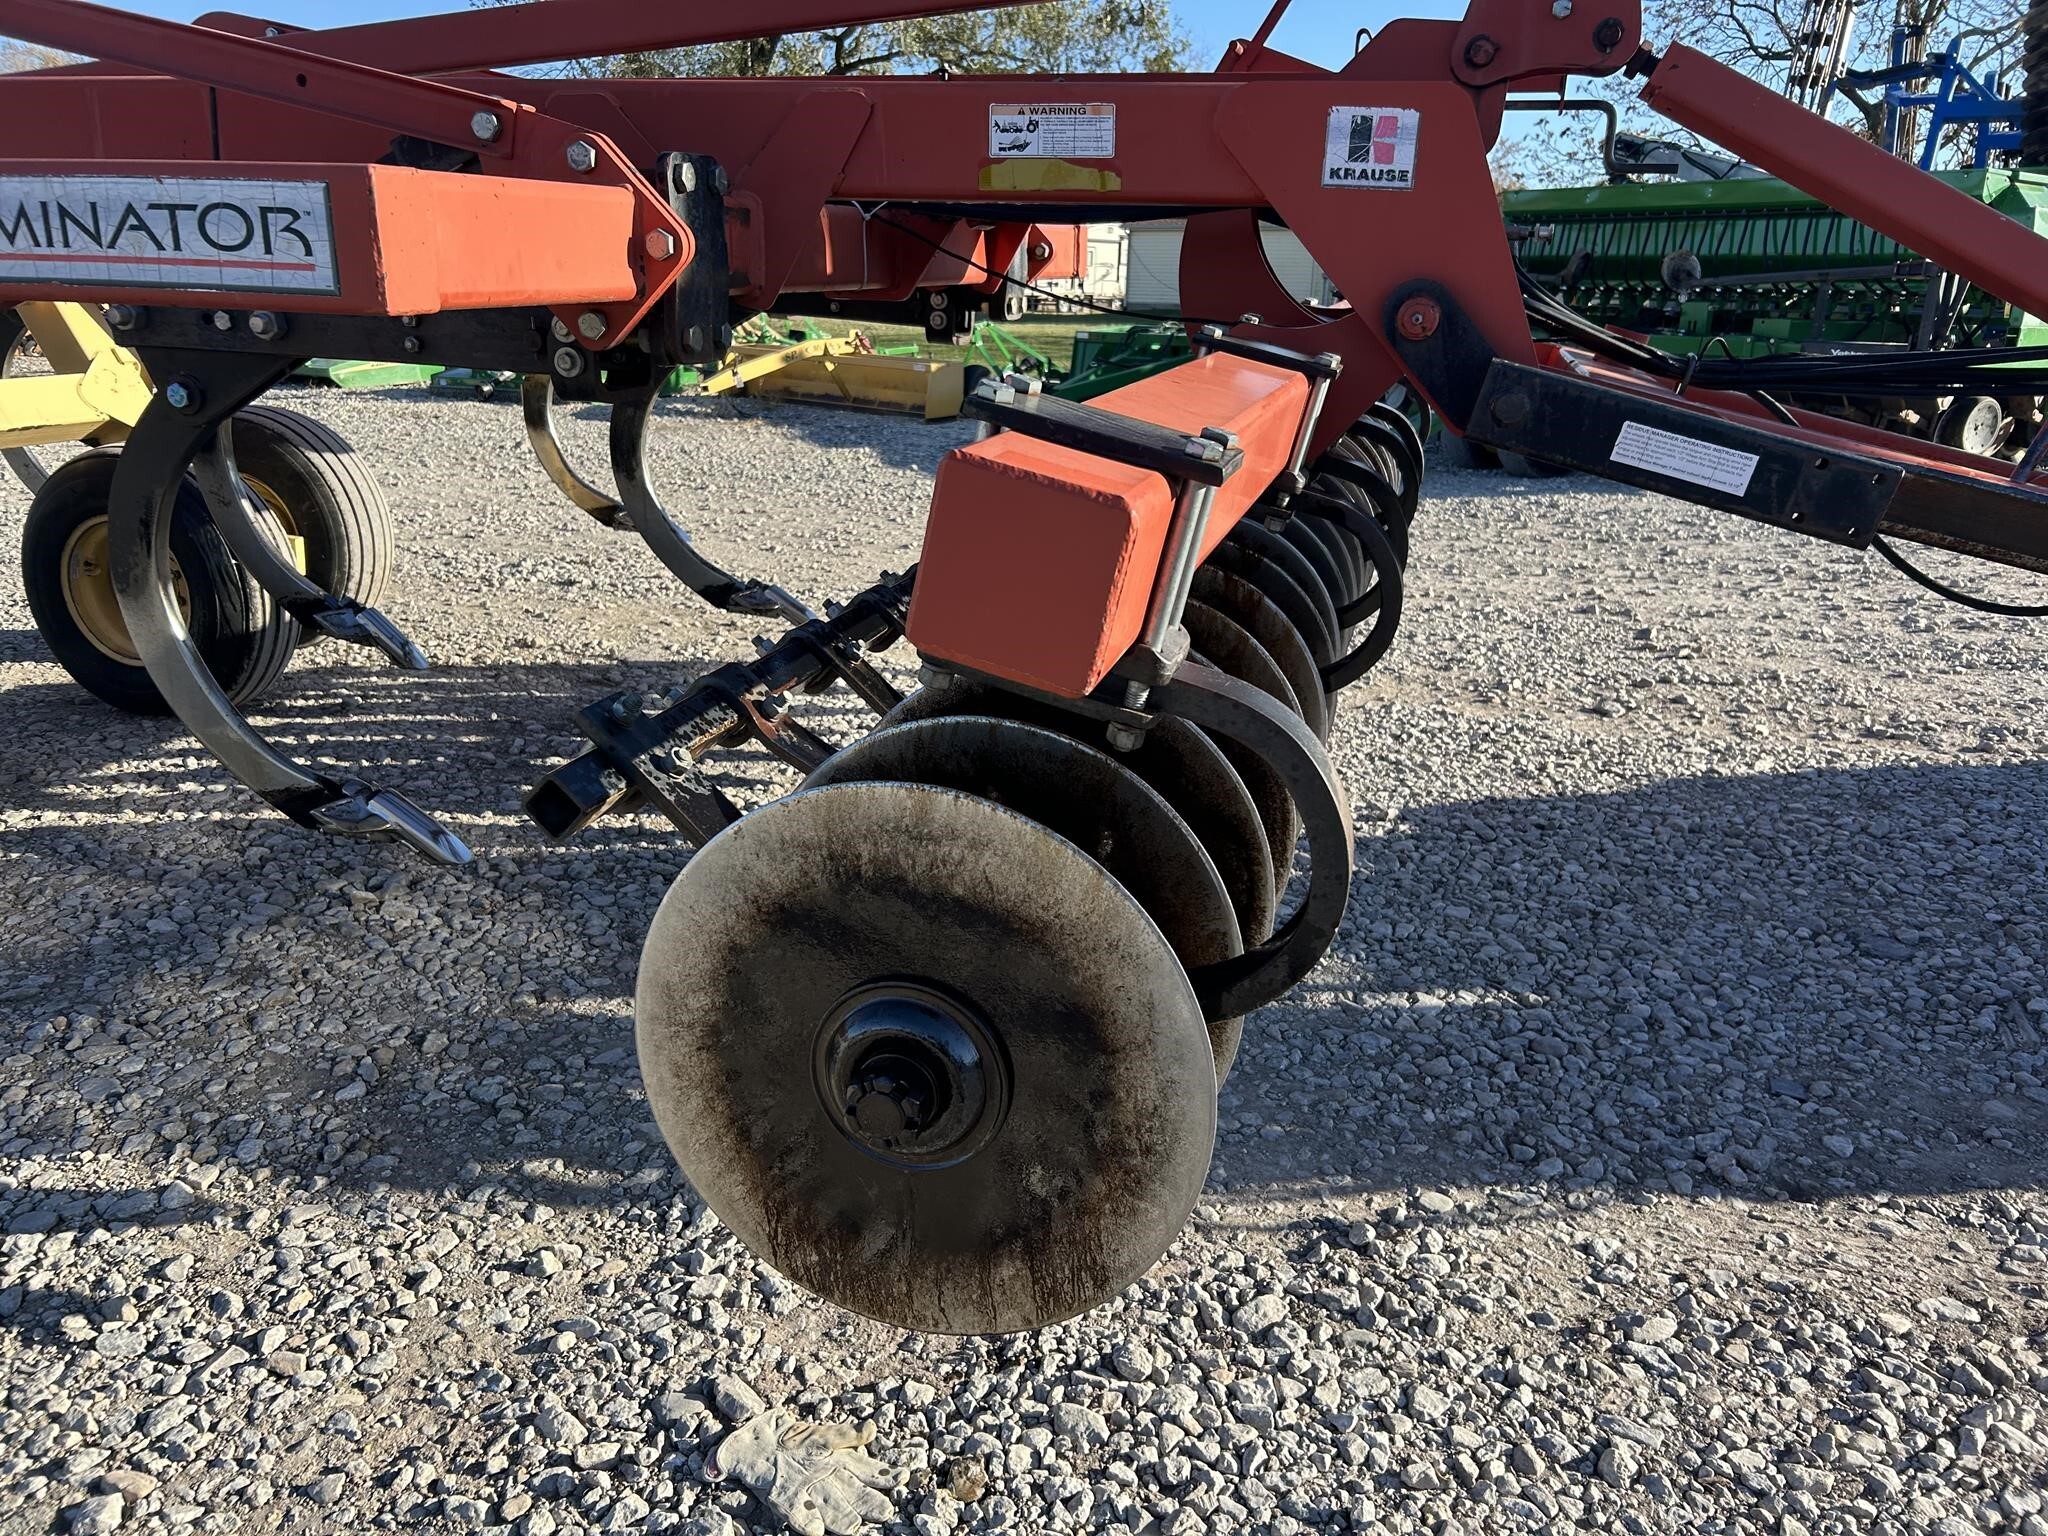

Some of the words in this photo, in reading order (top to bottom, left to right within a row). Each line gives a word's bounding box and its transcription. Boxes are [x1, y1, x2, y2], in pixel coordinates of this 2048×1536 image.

[1029, 107, 1087, 115] WARNING
[1329, 167, 1409, 182] KRAUSE
[1626, 423, 1650, 435] RESIDUE
[1651, 430, 1679, 443] MANAGER
[1680, 438, 1711, 451] OPERATING
[1712, 446, 1753, 462] INSTRUCTIONS
